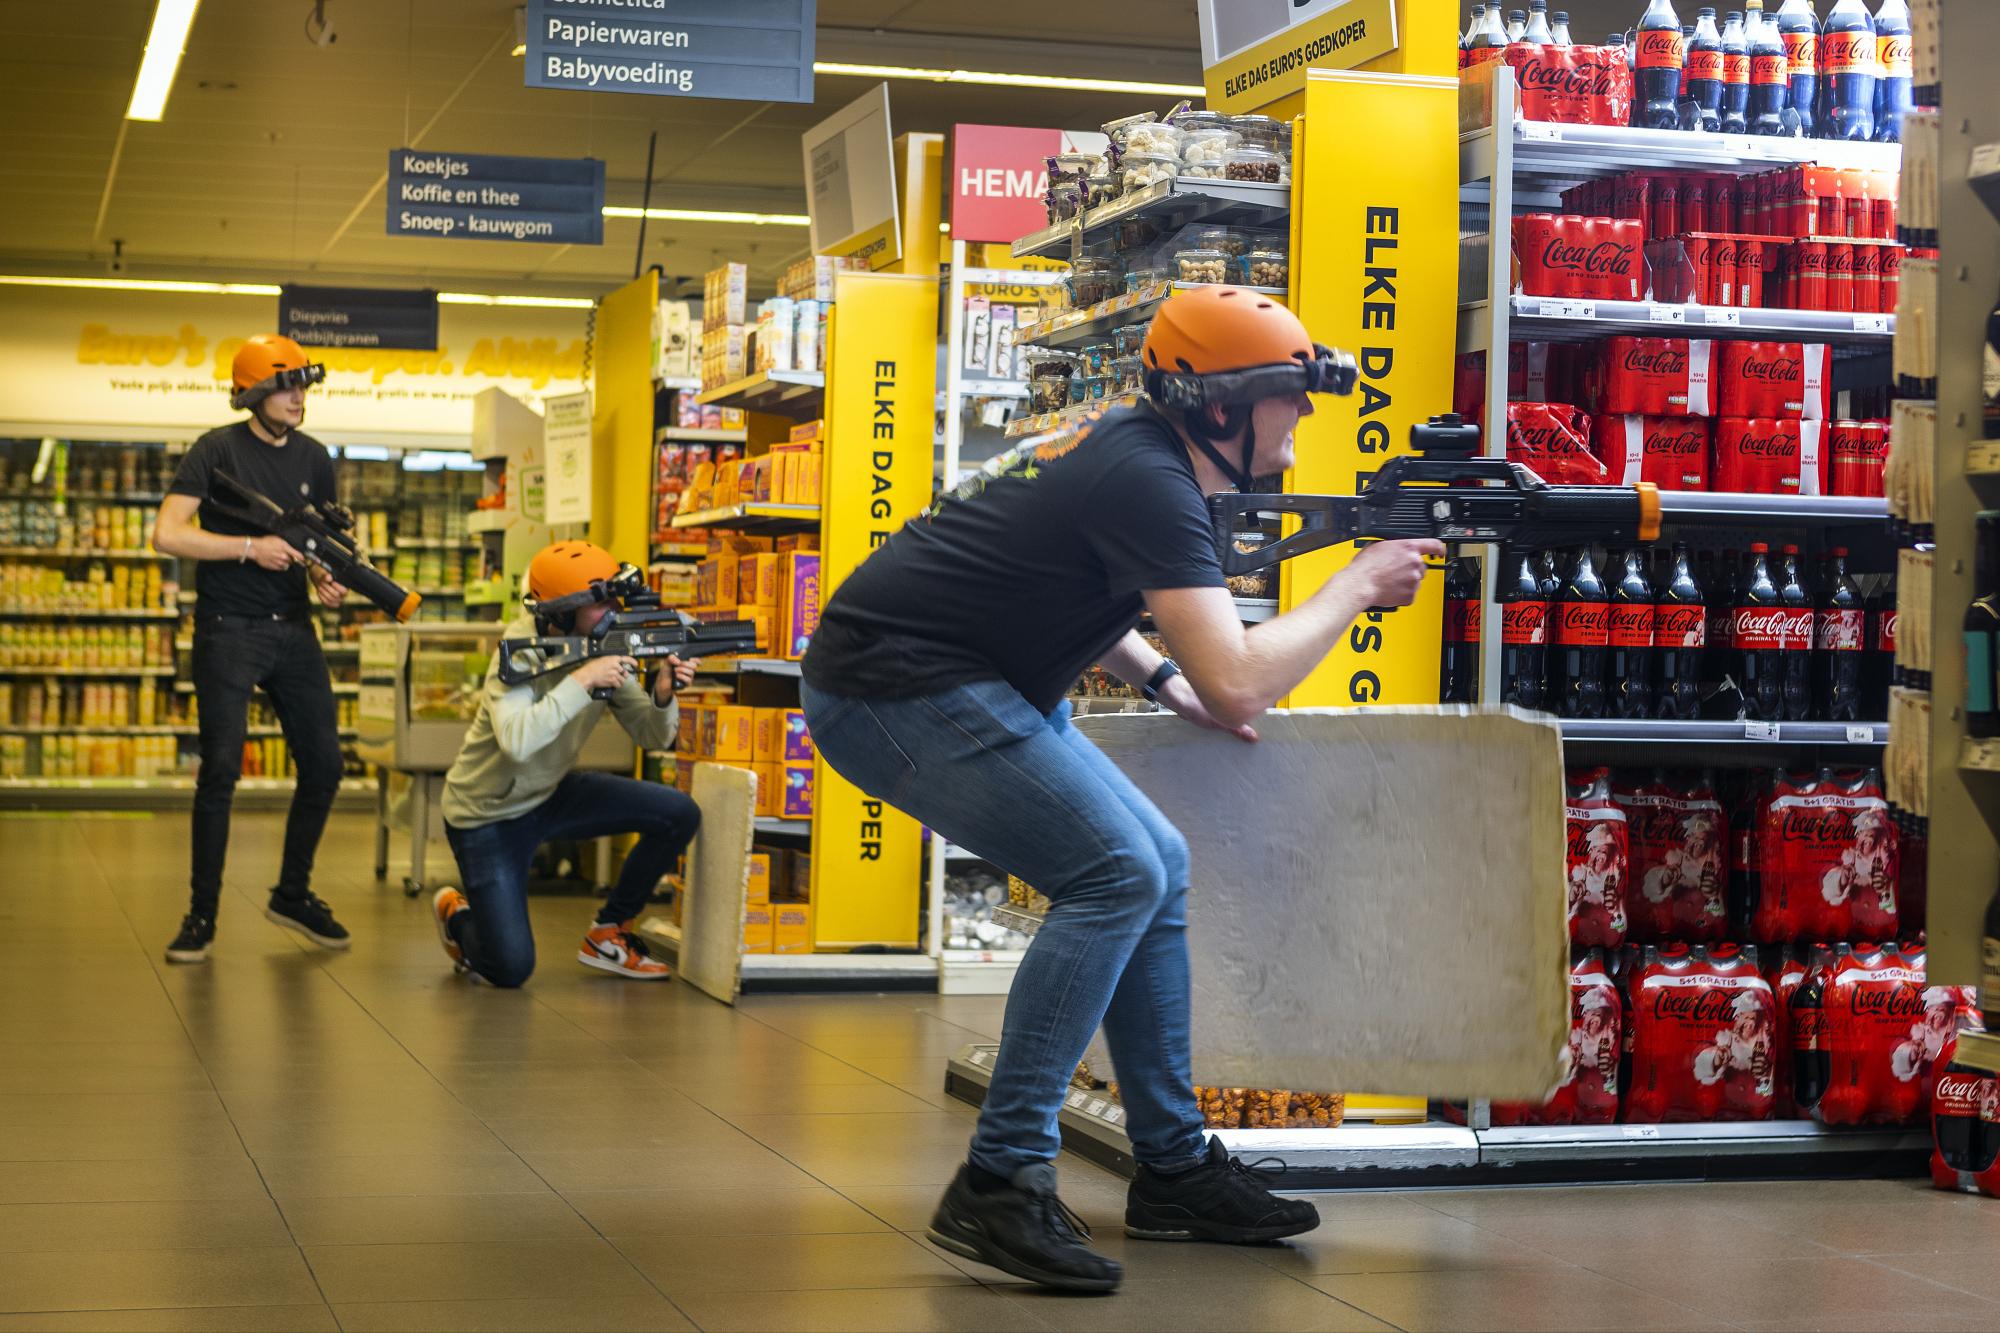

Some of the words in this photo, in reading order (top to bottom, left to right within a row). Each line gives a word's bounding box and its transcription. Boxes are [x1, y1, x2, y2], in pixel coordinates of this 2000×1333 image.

[548, 18, 690, 48] Papierwaren
[1225, 72, 1248, 98] ELKE
[1248, 63, 1268, 88] DAG
[1269, 47, 1304, 79] EURO'S
[1305, 19, 1366, 63] GOEDKOPER
[547, 56, 694, 91] Babyvoeding
[1518, 58, 1617, 96] Coca-Cola
[403, 156, 469, 179] Koekjes
[401, 183, 452, 204] Koffie
[456, 191, 477, 204] en
[480, 187, 520, 206] thee
[961, 168, 1049, 199] HEMA
[400, 211, 455, 234] Snoep
[468, 215, 553, 238] kauwgom
[1362, 206, 1399, 331] ELKE
[1542, 238, 1636, 275] Coca-Cola
[978, 283, 1040, 297] URO'S
[290, 309, 349, 326] Diepvries
[289, 329, 380, 347] Ontbijtgranen
[1624, 349, 1688, 373] Coca-Cola
[1742, 356, 1802, 381] Coca-Cola
[873, 360, 896, 440] ELKE
[1356, 346, 1394, 454] DAG
[1644, 431, 1706, 455] Coca-Cola
[1739, 433, 1798, 456] Coca-Cola
[870, 451, 893, 519] DAG
[803, 576, 816, 636] VEGTER'S
[1566, 808, 1590, 818] RATIS
[1631, 796, 1649, 804] 5+1
[1650, 795, 1688, 808] GRATIS
[1803, 798, 1820, 806] 5+1
[1822, 796, 1856, 806] GRATIS
[1782, 809, 1863, 842] Coca-Cola
[1679, 977, 1696, 985] 5+1
[1699, 976, 1738, 986] GRATIS
[1870, 970, 1888, 980] 5+1
[1889, 969, 1924, 981] GRATIS
[1654, 988, 1739, 1023] Coca-Cola
[1851, 983, 1930, 1016] Coca-Cola
[1944, 1101, 1972, 1109] ORIGINAL
